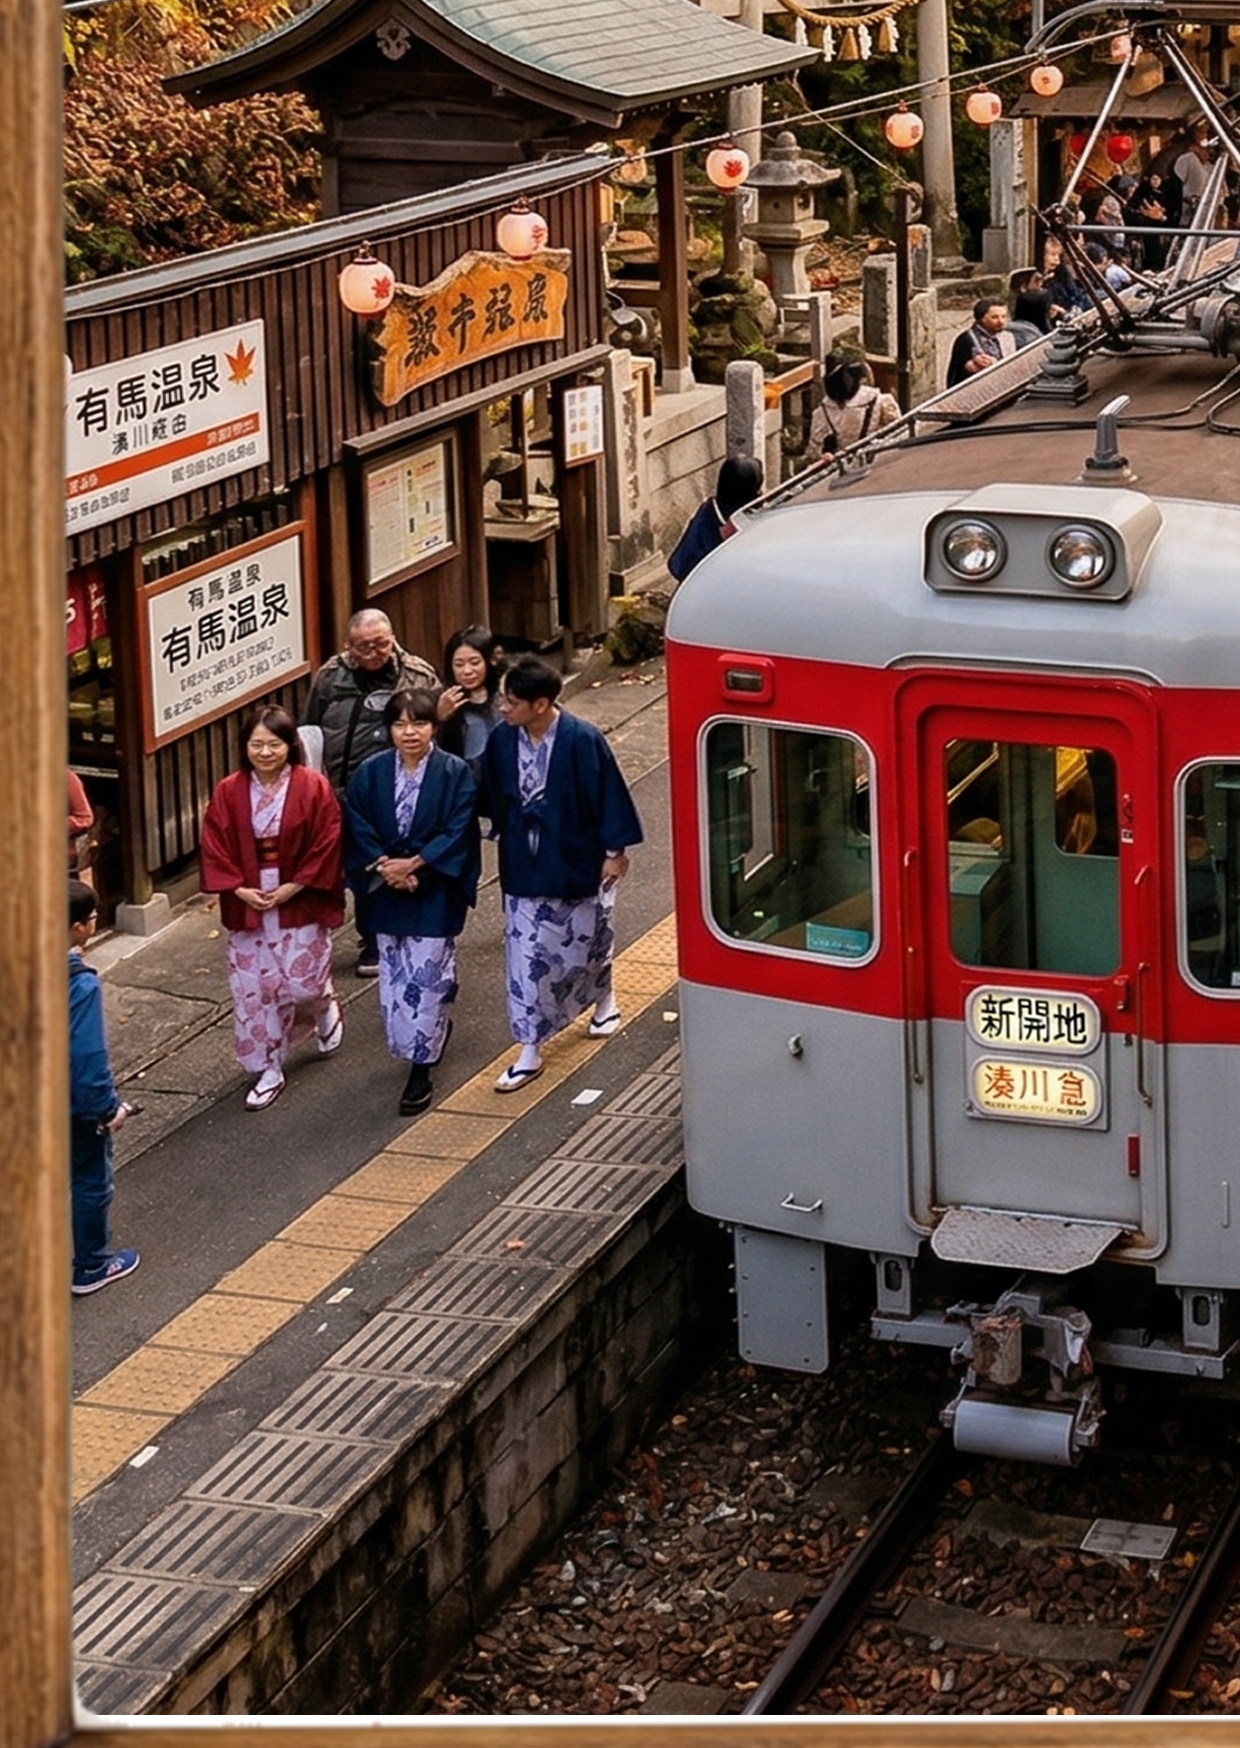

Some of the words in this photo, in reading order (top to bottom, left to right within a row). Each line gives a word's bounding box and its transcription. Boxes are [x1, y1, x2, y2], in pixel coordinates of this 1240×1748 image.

[76, 354, 220, 437] 有馬温泉
[162, 583, 289, 673] 有馬温泉
[981, 994, 1087, 1044] 新開地
[984, 1065, 1087, 1107] 湊川急
